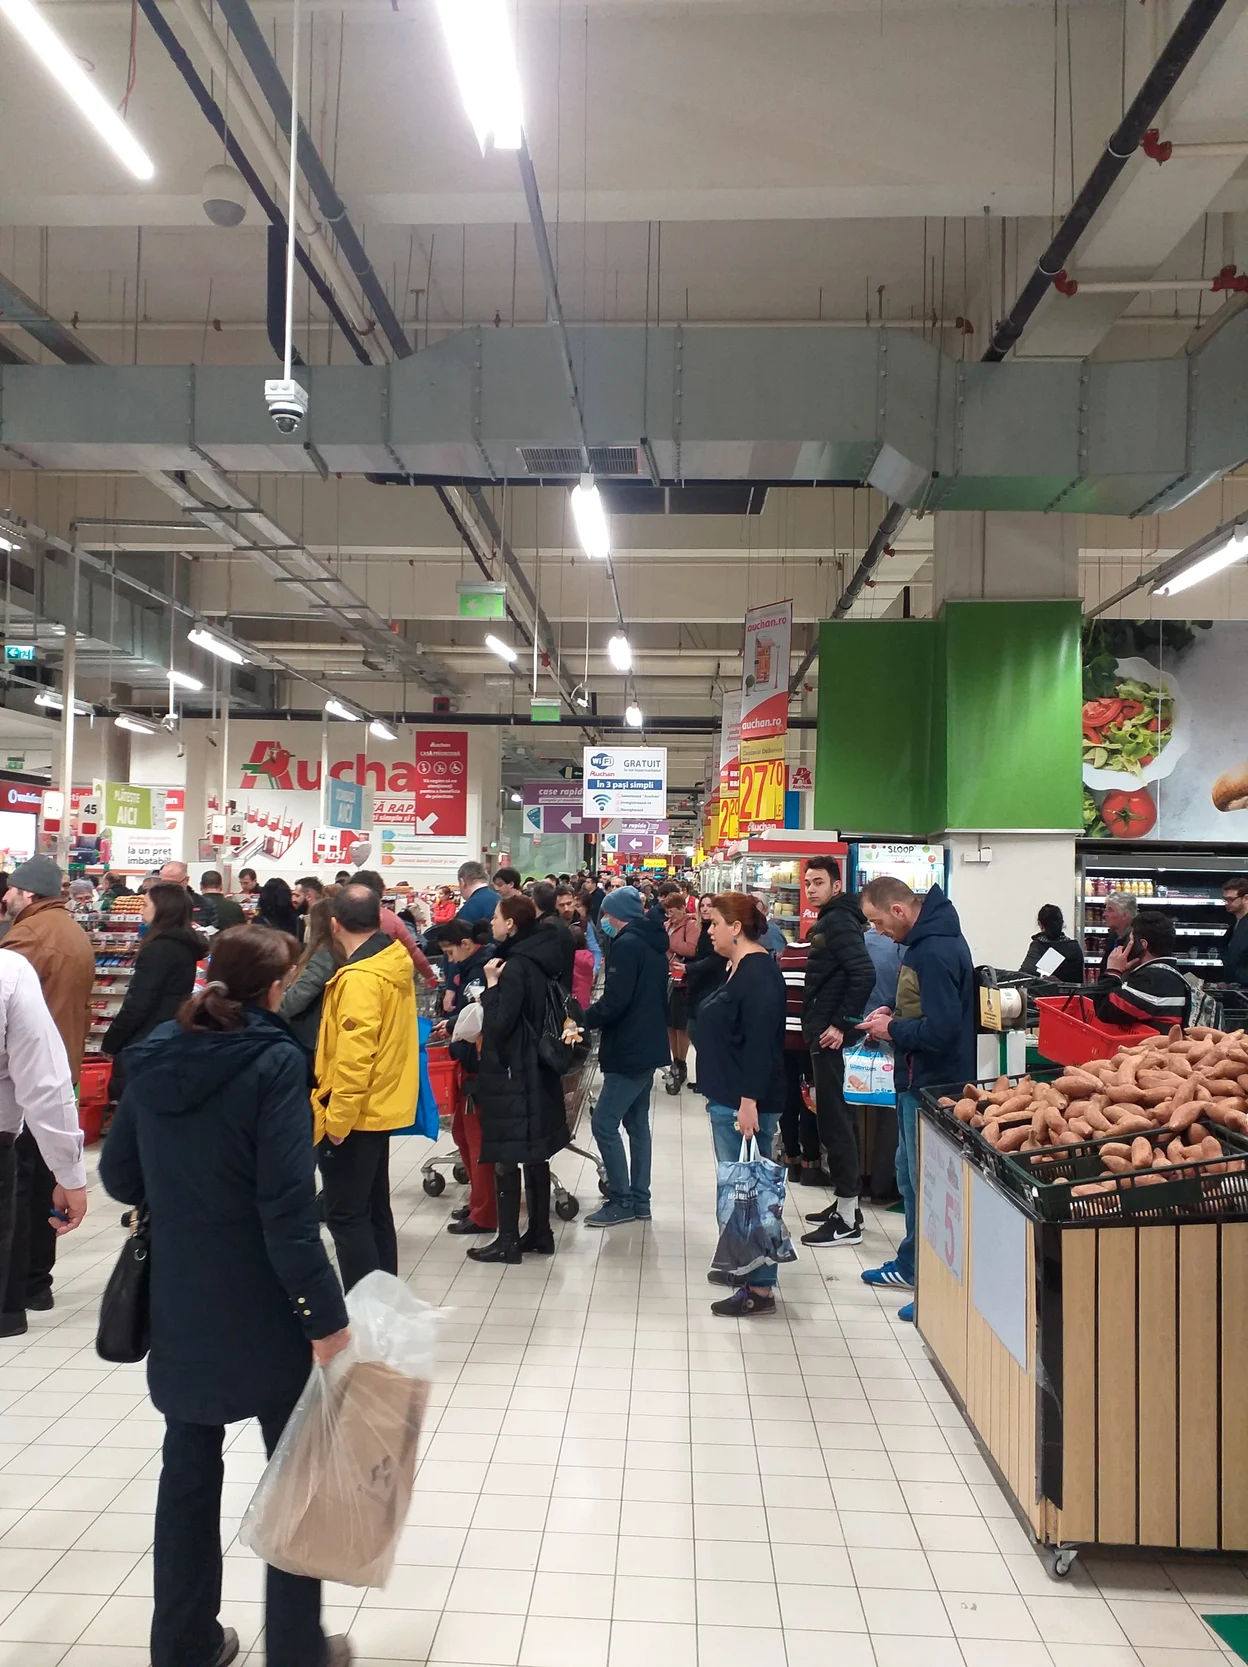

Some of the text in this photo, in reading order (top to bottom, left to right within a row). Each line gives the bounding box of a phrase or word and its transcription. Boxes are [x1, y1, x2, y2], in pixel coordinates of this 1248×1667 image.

[747, 617, 787, 632] auchan.ro
[742, 718, 782, 730] auchan.ro
[240, 741, 416, 792] Aucha
[623, 760, 661, 768] GRATUIT
[613, 782, 629, 790] pași
[630, 781, 654, 790] simpli
[560, 788, 583, 797] rapid
[84, 804, 97, 814] 45
[388, 802, 415, 813] RAP
[116, 805, 138, 825] AICI
[720, 800, 729, 837] 2
[231, 824, 241, 832] 43
[748, 821, 776, 831] Auchan
[127, 846, 136, 854] la
[888, 845, 914, 853] SLOOP
[127, 857, 171, 865] imbatabil
[945, 1192, 954, 1268] 5
